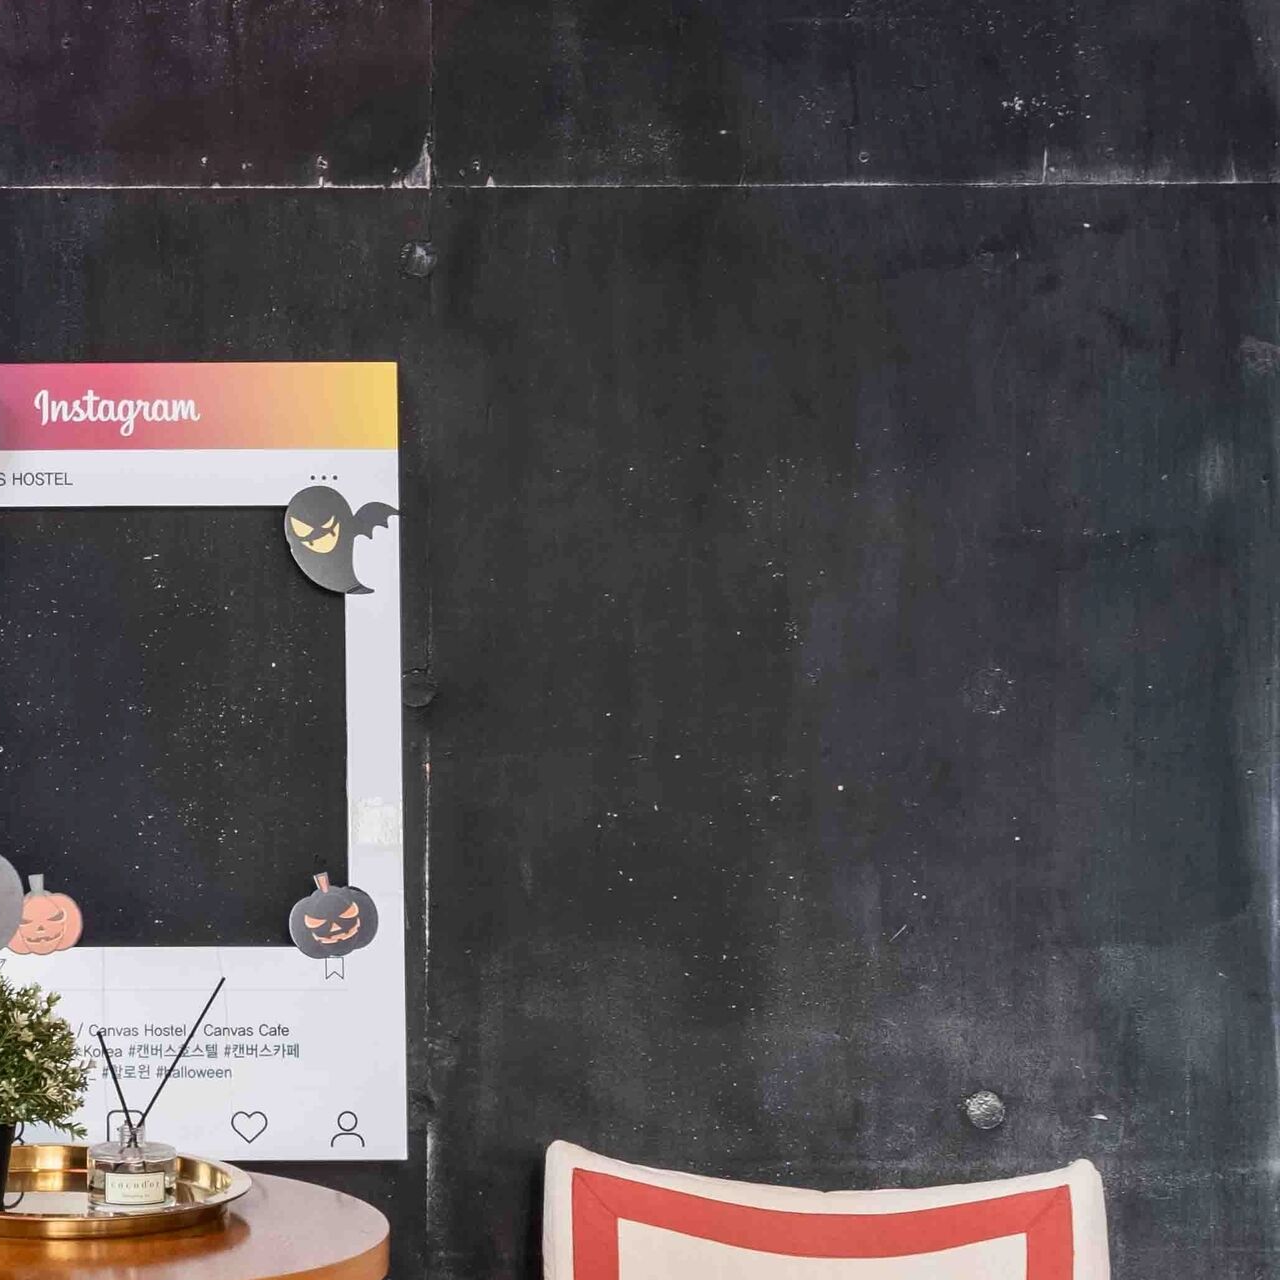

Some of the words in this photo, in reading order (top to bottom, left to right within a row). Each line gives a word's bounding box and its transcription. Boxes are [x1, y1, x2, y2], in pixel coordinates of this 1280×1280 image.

[33, 388, 202, 438] Instagram
[11, 472, 74, 487] HOSTEL
[88, 1023, 140, 1037] Canvas
[144, 1023, 188, 1037] Hostel
[203, 1023, 254, 1037] Canvas
[258, 1023, 290, 1037] Cafe
[224, 1043, 300, 1059] #캔버스카페
